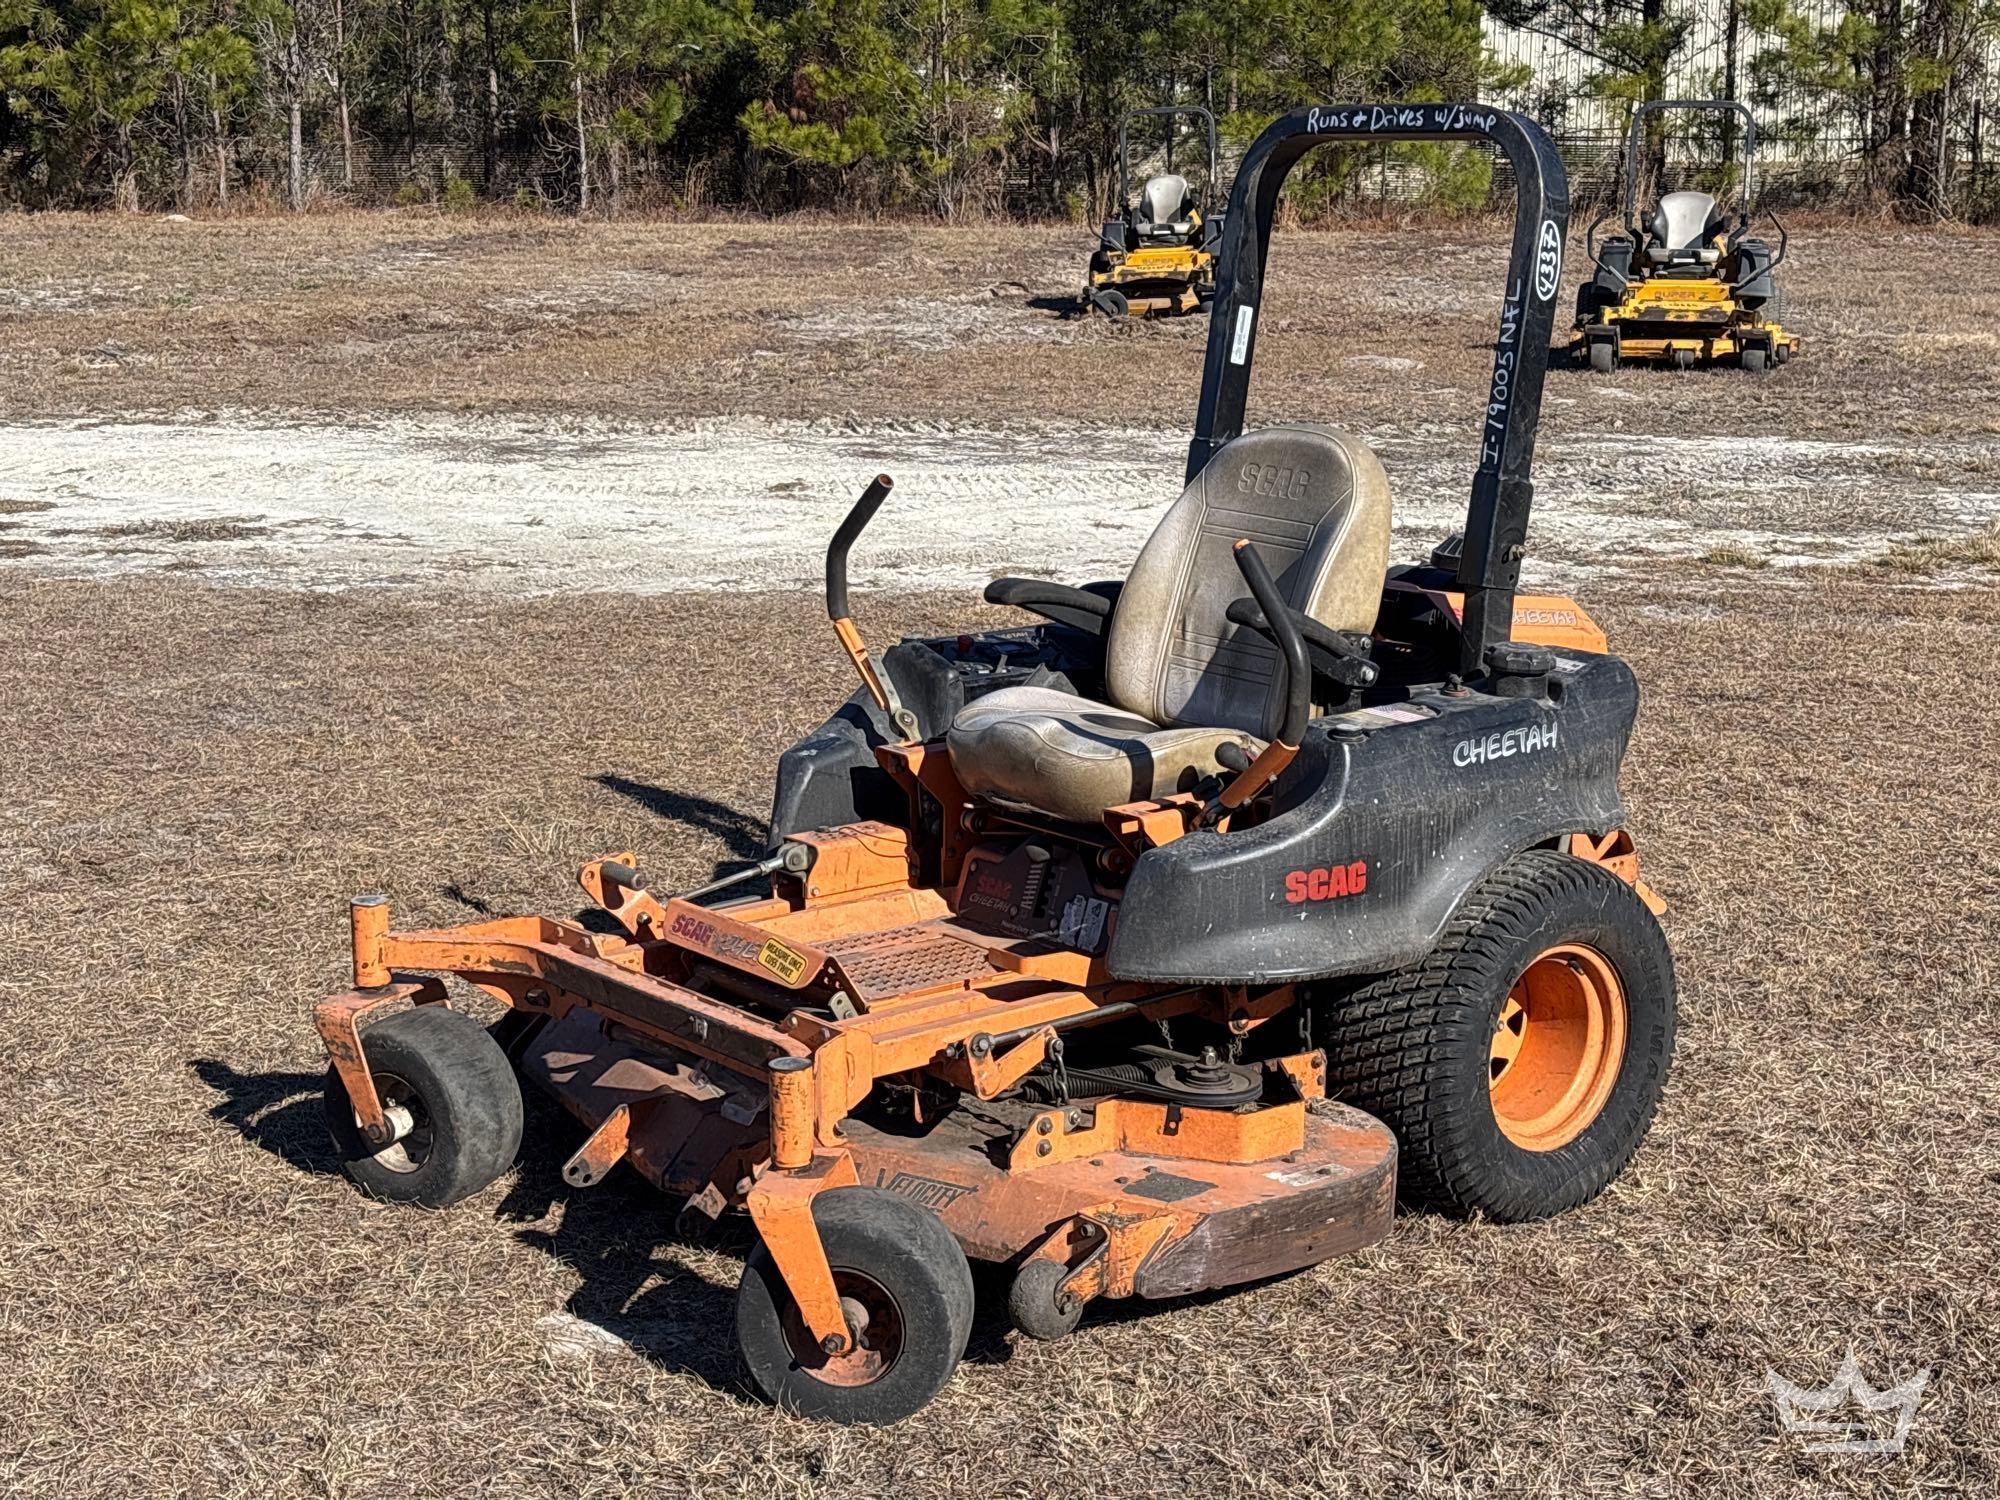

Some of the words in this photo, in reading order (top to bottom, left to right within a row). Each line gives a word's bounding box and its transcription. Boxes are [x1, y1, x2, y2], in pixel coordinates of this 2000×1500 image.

[1307, 107, 1348, 135] Runs
[1370, 106, 1424, 133] Drives
[1539, 229, 1557, 293] 4337
[1237, 462, 1312, 501] SCAG
[1453, 722, 1558, 767] CHEETAH
[1285, 859, 1368, 904] SCAG
[969, 892, 1012, 913] CHEETAH
[671, 914, 715, 943] SCAG
[767, 941, 791, 962] MEASURE
[789, 955, 804, 971] ONCE
[776, 961, 795, 979] TWICE
